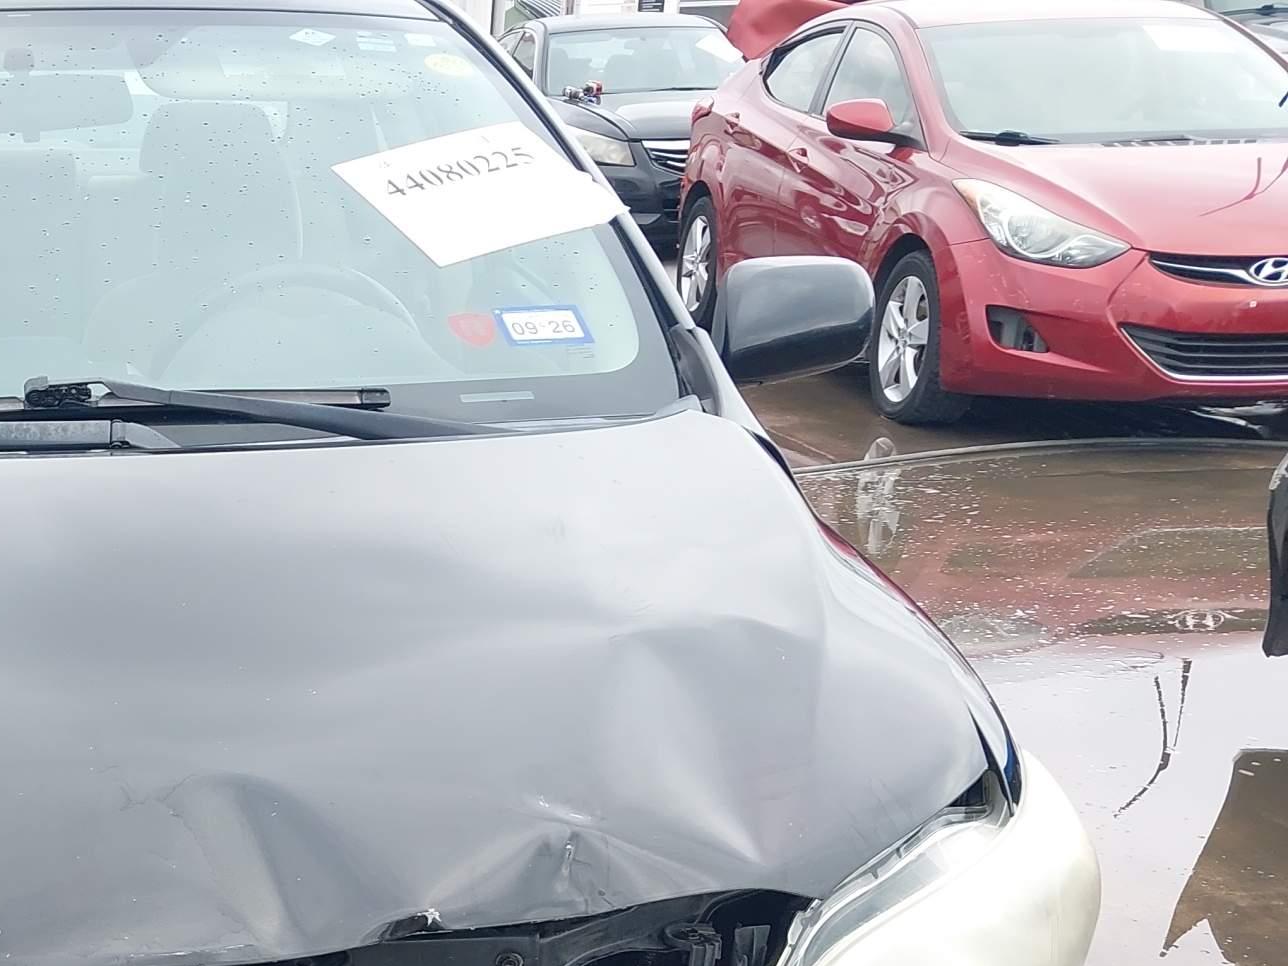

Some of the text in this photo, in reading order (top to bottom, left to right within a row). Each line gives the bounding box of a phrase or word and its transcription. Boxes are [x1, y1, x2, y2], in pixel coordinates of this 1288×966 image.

[386, 147, 535, 196] 44080225
[511, 319, 576, 336] 09 26
